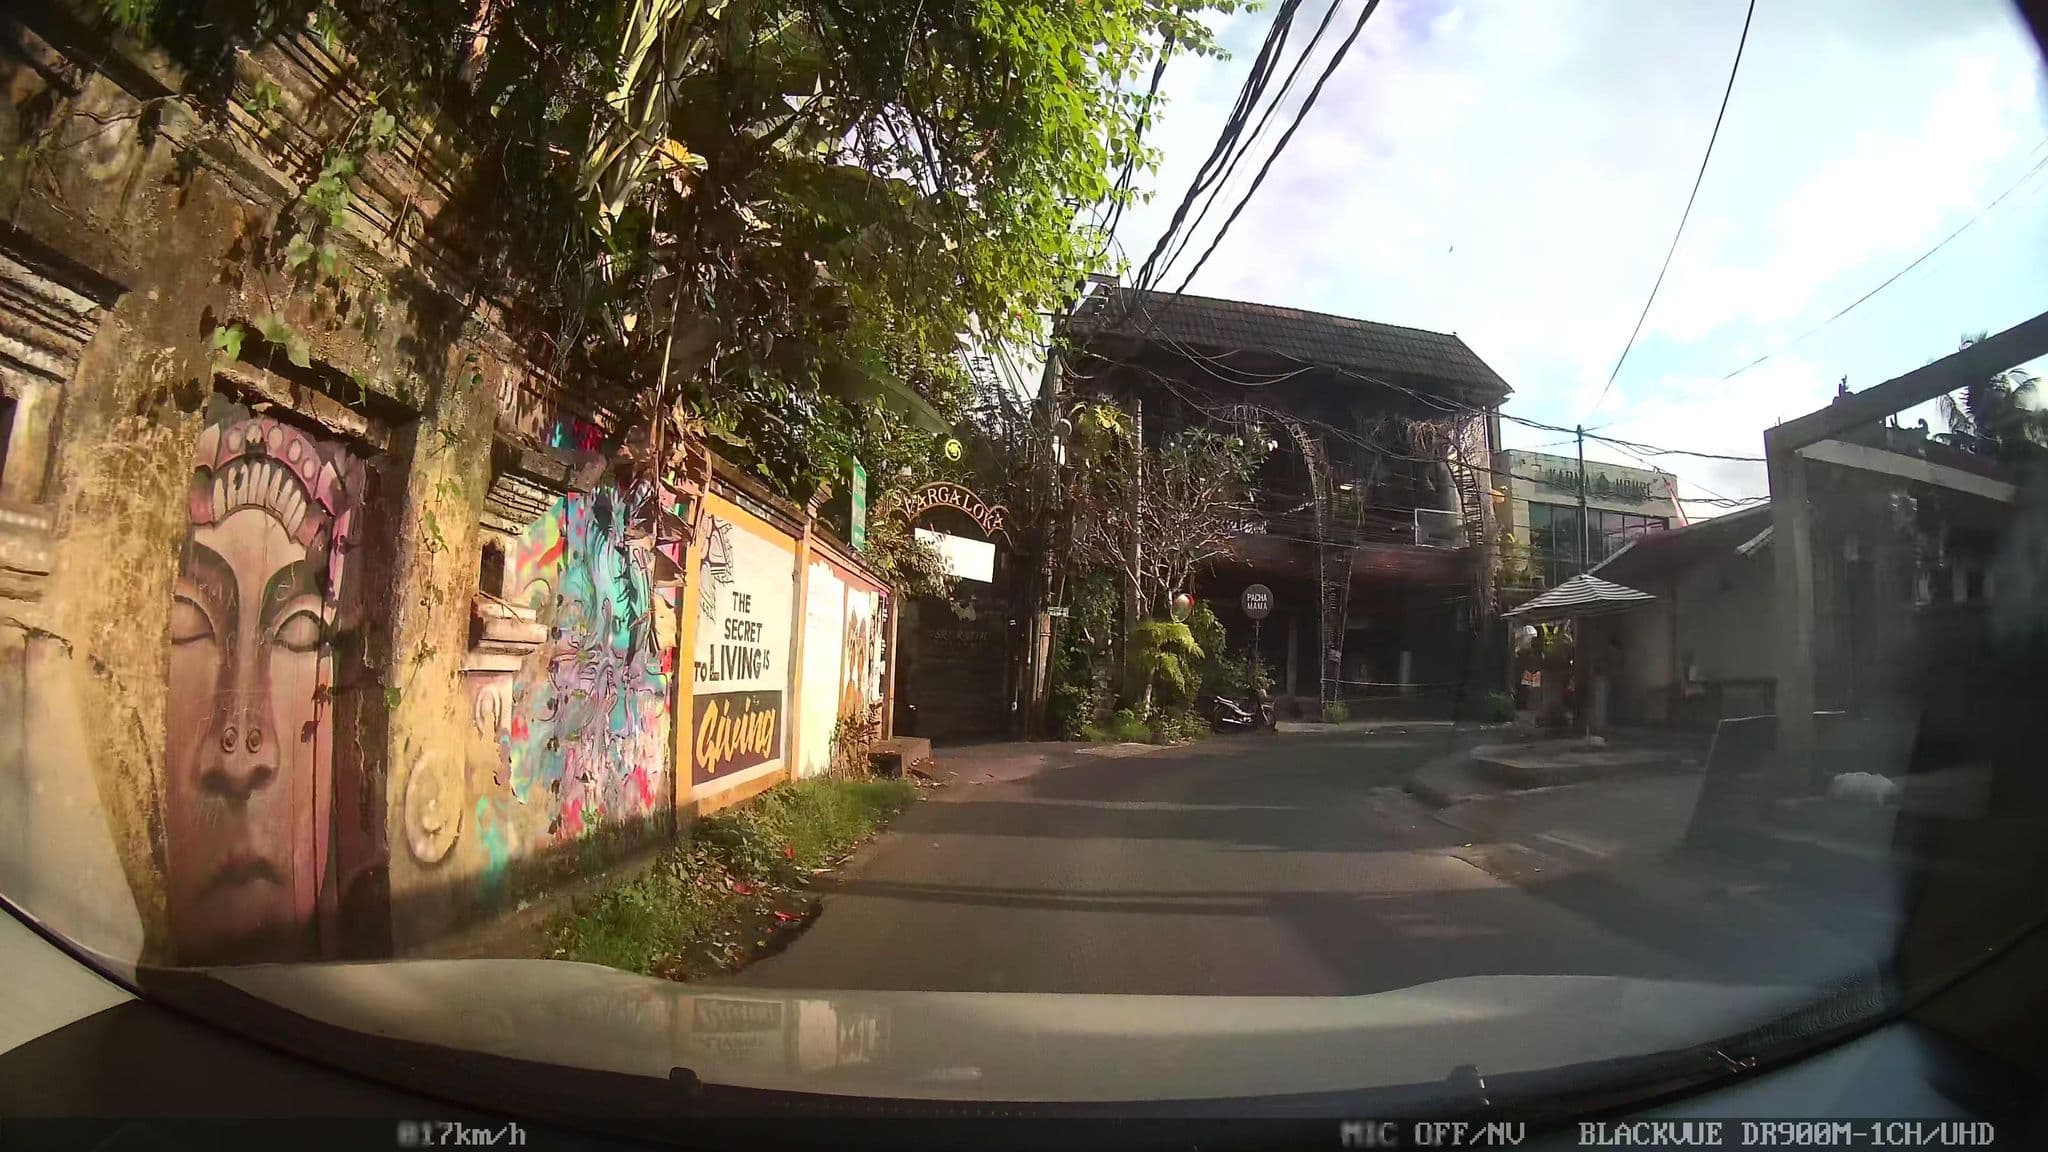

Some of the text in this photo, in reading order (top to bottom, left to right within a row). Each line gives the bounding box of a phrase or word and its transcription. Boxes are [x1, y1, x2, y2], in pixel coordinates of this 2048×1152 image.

[732, 591, 751, 613] THE
[1247, 593, 1267, 602] PACHA
[724, 618, 763, 643] SECRET
[709, 644, 762, 682] LIVING
[763, 649, 770, 670] IS
[697, 698, 776, 774] Giving
